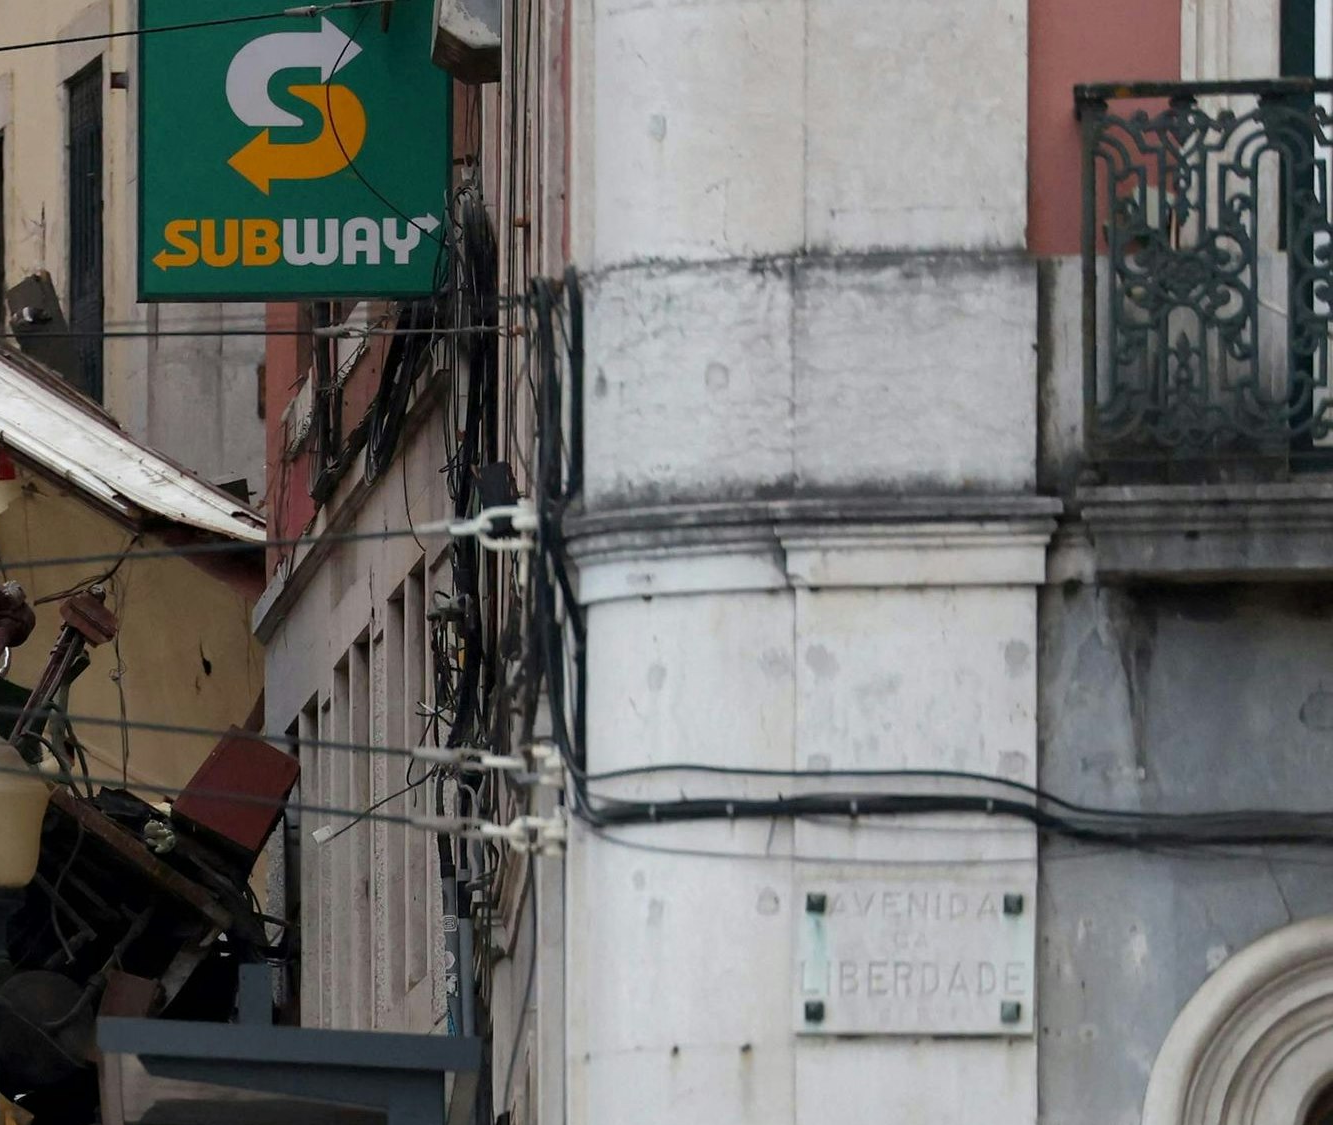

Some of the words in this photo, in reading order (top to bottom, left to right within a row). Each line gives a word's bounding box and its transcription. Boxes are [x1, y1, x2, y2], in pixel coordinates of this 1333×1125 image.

[152, 213, 441, 271] SUBWAY
[827, 891, 1000, 920] AVENIDA
[799, 959, 1026, 998] LIBERDADE
